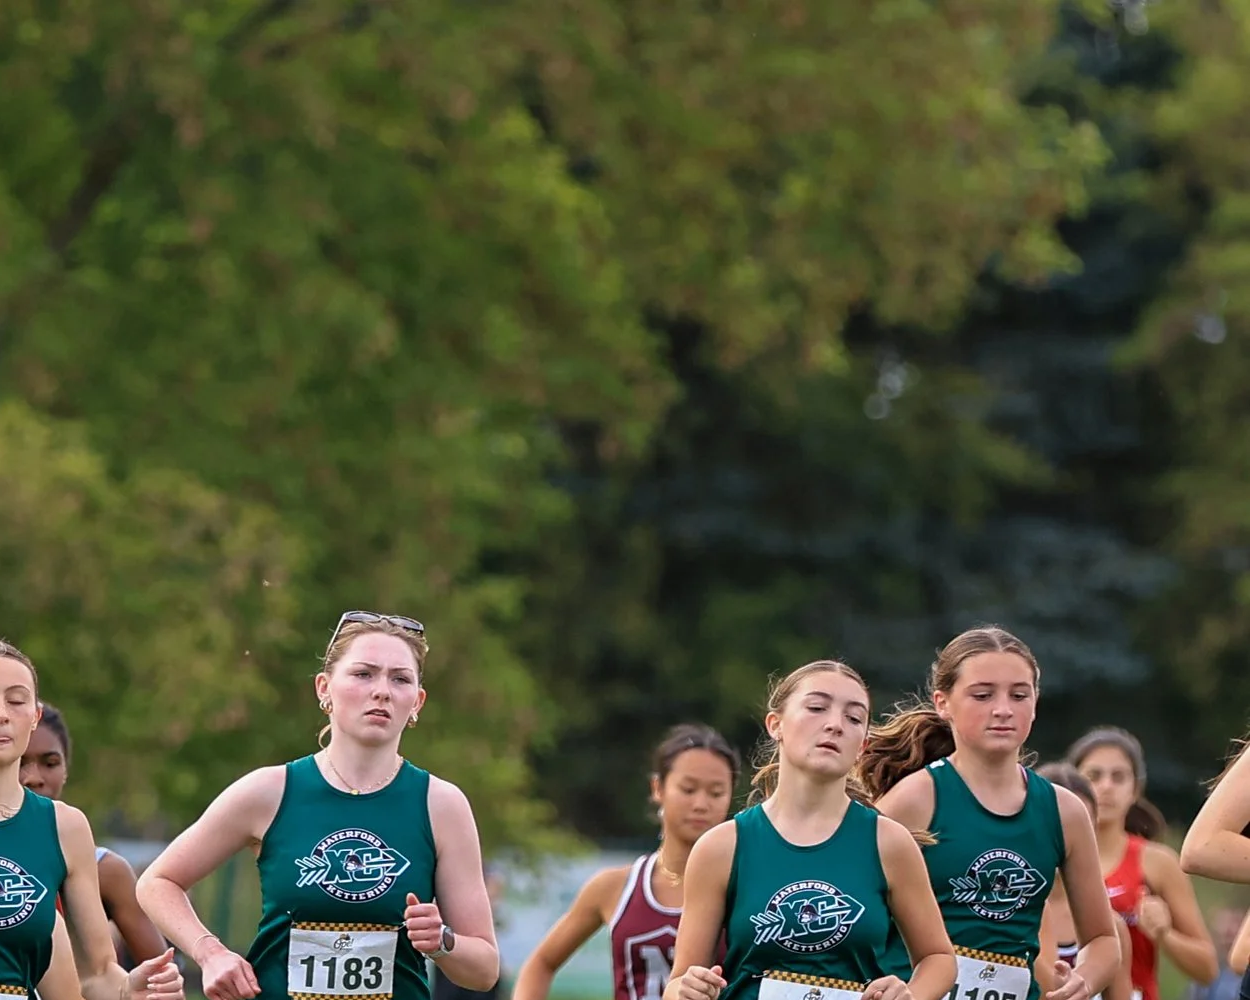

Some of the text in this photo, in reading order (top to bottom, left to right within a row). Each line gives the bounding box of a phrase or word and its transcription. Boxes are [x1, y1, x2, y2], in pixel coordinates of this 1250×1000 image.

[317, 830, 381, 851] WATERFORD
[972, 851, 1026, 871] WATERFORD
[326, 877, 392, 901] KETTERING
[771, 881, 835, 905] WATERFORD
[783, 925, 848, 952] KETTERING
[300, 955, 383, 990] 1183
